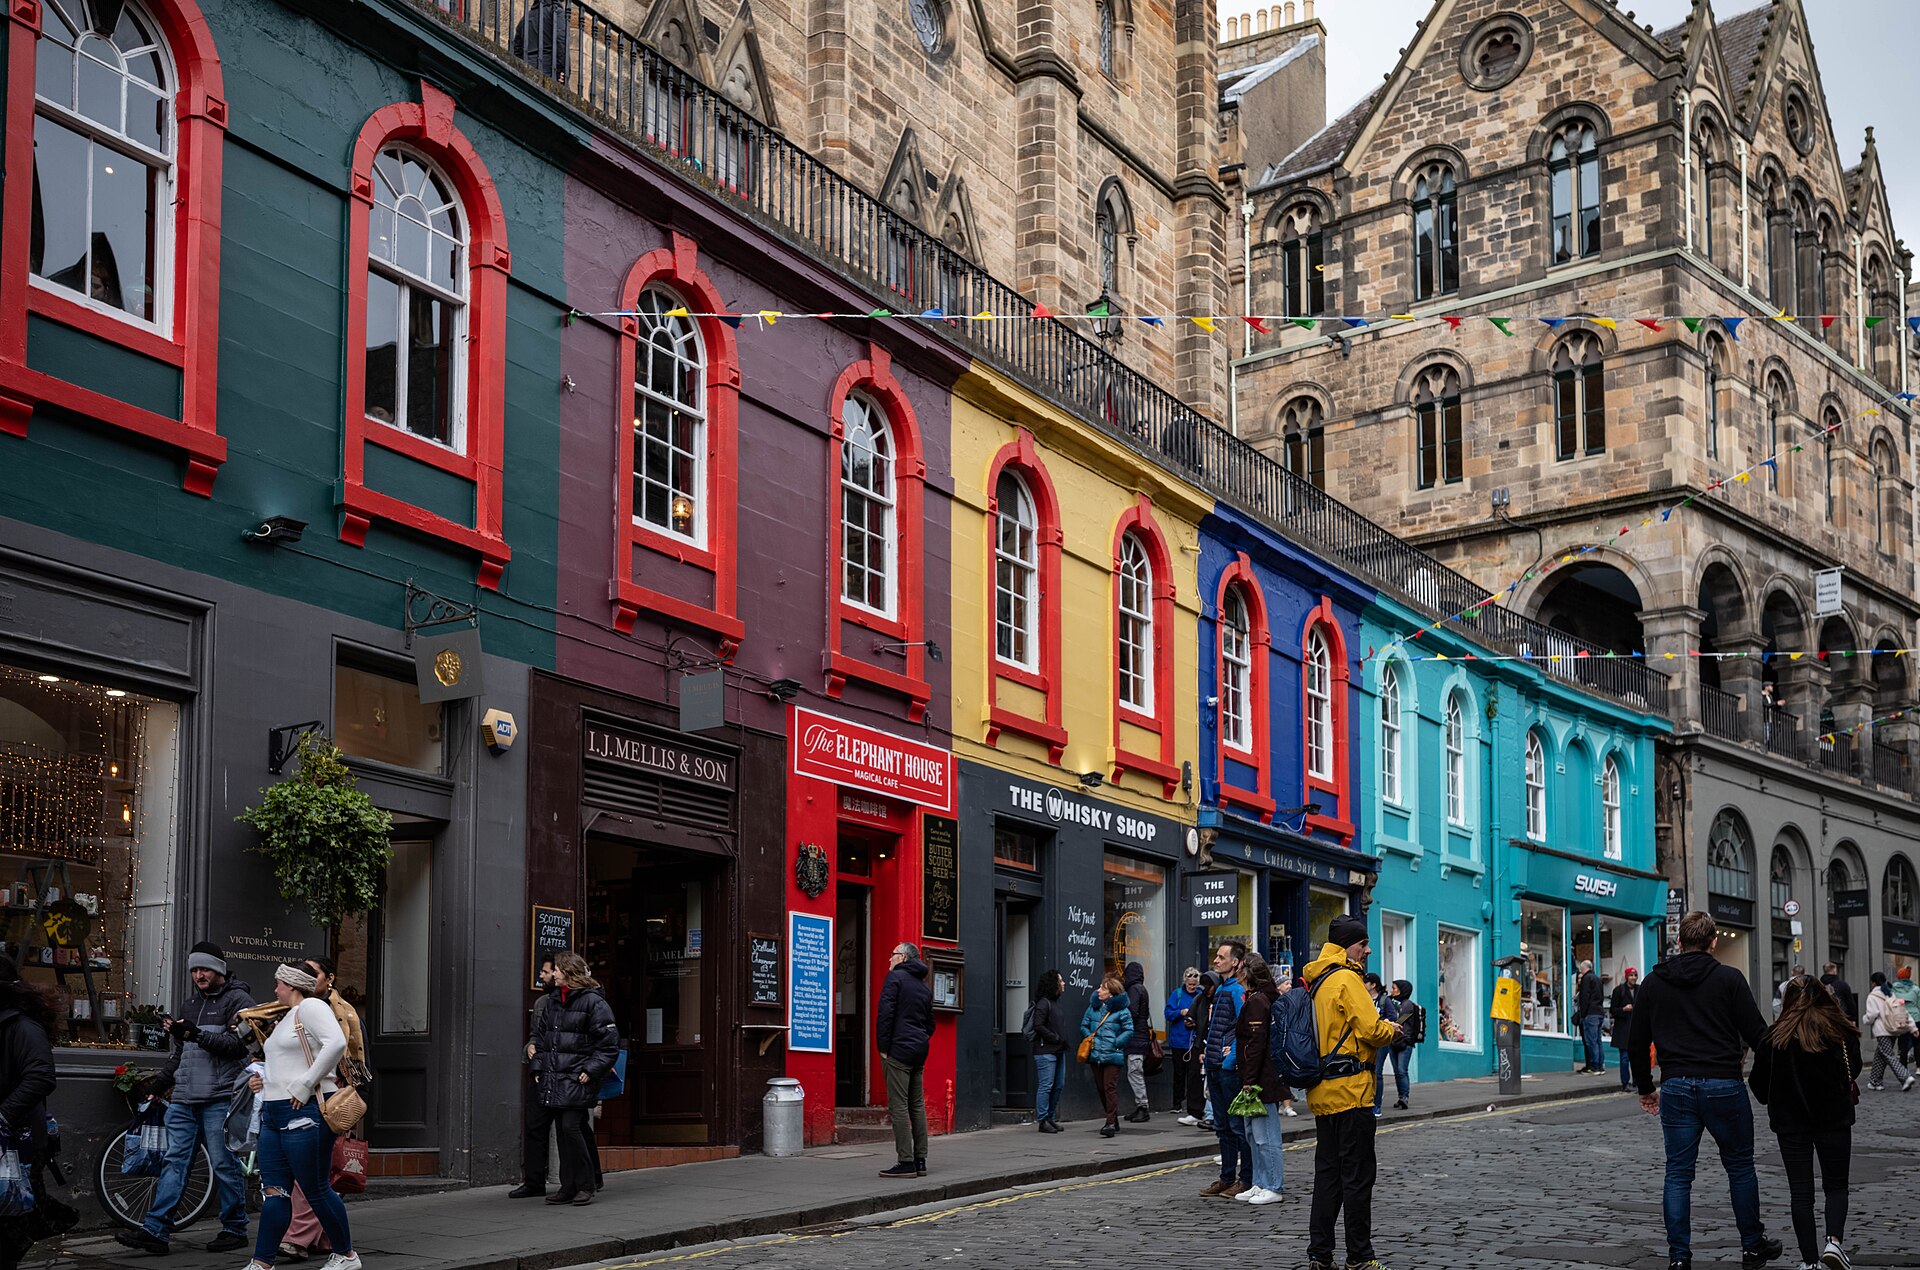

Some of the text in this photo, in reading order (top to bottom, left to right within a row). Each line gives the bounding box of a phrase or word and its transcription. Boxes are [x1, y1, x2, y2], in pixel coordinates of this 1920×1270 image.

[497, 722, 511, 734] ADT
[804, 724, 943, 786] The ELEPHANT HOUSE
[680, 753, 690, 775] &
[694, 757, 727, 783] SON
[854, 769, 899, 789] MAGICAL CAFE
[1009, 785, 1156, 841] THE WHISKY SHOP
[929, 843, 952, 857] BUTTER
[928, 854, 953, 868] SCOTCH
[932, 866, 949, 879] BEER
[1204, 881, 1224, 890] THE
[1575, 874, 1617, 897] SWISH
[1193, 894, 1235, 907] WHISKY
[539, 914, 571, 927] SCOTTISH
[1068, 905, 1081, 922] Not
[1201, 910, 1228, 920] SHOP
[263, 927, 273, 937] 32
[541, 925, 565, 936] CHEESE
[1068, 929, 1096, 946] Another
[230, 935, 305, 950] VICTORIA STREET
[540, 936, 567, 948] PLATTER
[1068, 949, 1095, 974] Whisky
[343, 1151, 364, 1159] CASTLE
